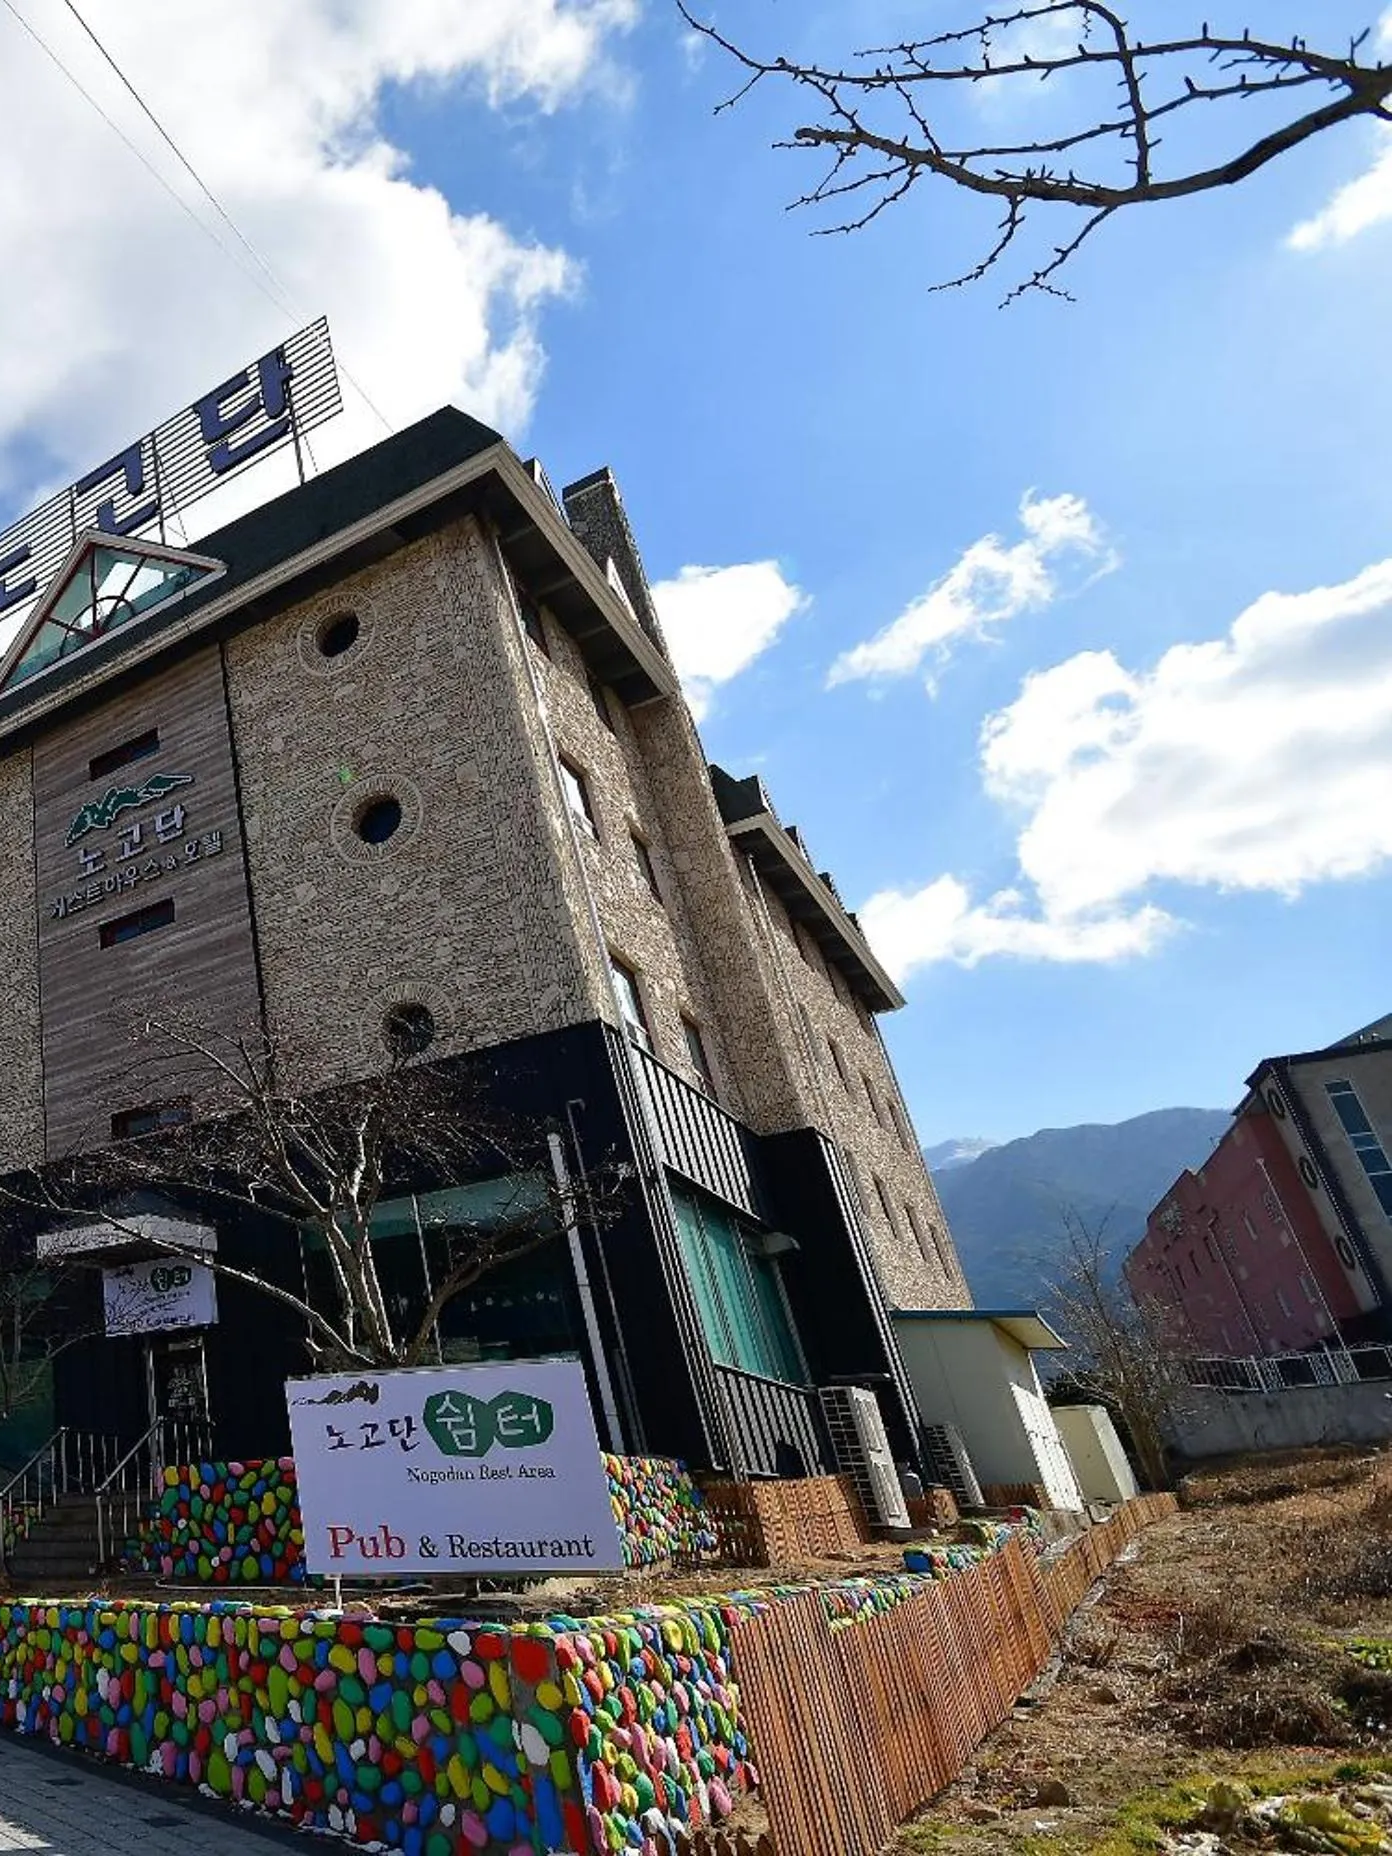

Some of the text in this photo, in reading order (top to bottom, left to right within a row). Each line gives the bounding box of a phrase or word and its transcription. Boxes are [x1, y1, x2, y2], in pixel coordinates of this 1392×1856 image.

[76, 803, 185, 881] 노고단
[326, 1394, 541, 1452] 노고단 쉼터
[518, 1464, 557, 1479] Area
[326, 1524, 596, 1560] Pub & Restaurant
